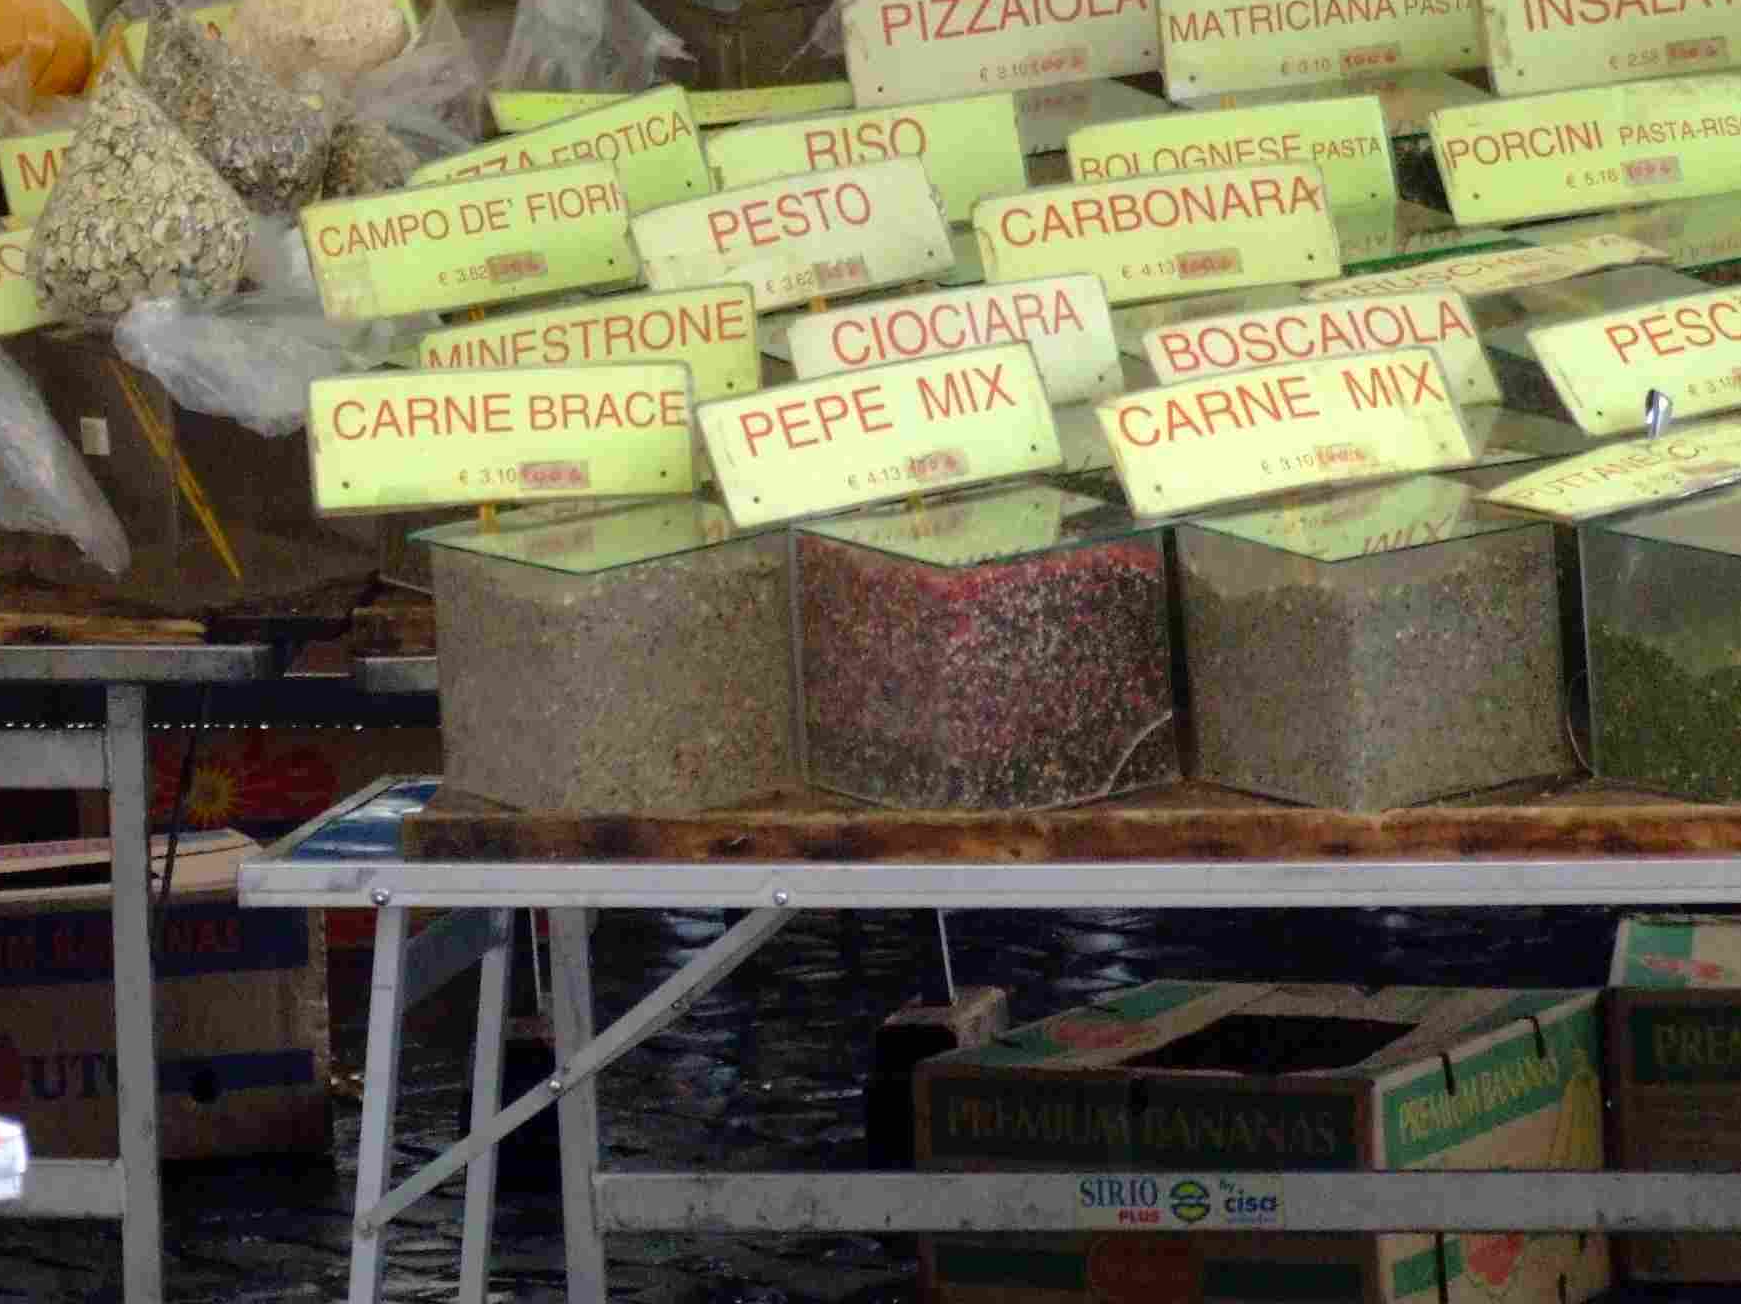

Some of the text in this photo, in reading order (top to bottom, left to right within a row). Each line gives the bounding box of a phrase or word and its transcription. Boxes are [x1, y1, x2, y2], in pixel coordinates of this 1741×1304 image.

[804, 117, 927, 170] RISO
[1312, 136, 1383, 160] PASTA
[1445, 120, 1605, 169] PORCINI
[318, 208, 451, 258] CAMPO
[526, 182, 620, 224] FIORI
[707, 182, 872, 254] PESTO
[999, 175, 1325, 248] CARBONARA
[427, 299, 748, 368] MINESTRONE
[832, 289, 1085, 367] CIOCIARA
[1159, 300, 1473, 374] BOSCAIOLA
[332, 391, 685, 440] CARNE BRACE
[739, 363, 1017, 457] PEPE MIX
[1117, 360, 1445, 447] CARNE MIX
[1079, 1178, 1158, 1208] SIRIO
[1118, 1208, 1161, 1225] PLUS
